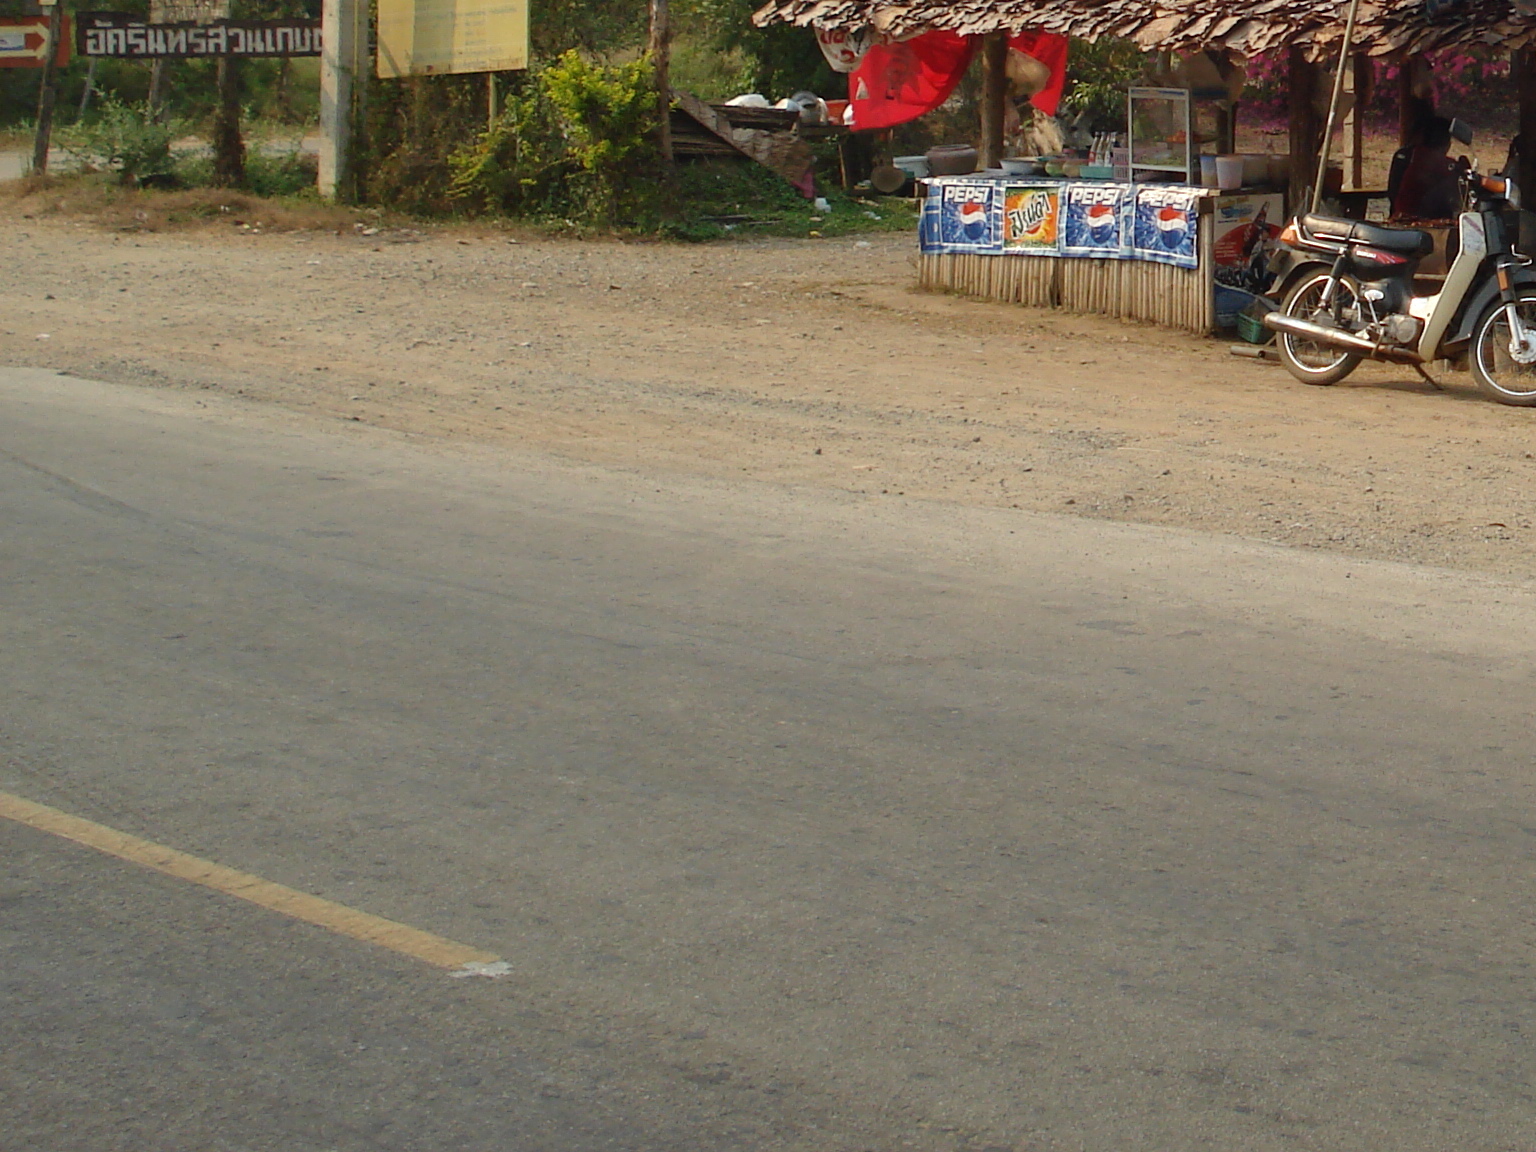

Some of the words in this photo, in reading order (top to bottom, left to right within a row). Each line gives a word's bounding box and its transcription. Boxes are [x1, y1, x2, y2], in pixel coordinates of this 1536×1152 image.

[944, 186, 989, 203] PEPSI
[1070, 186, 1121, 206] PEPSI
[1138, 188, 1195, 211] PEPSI
